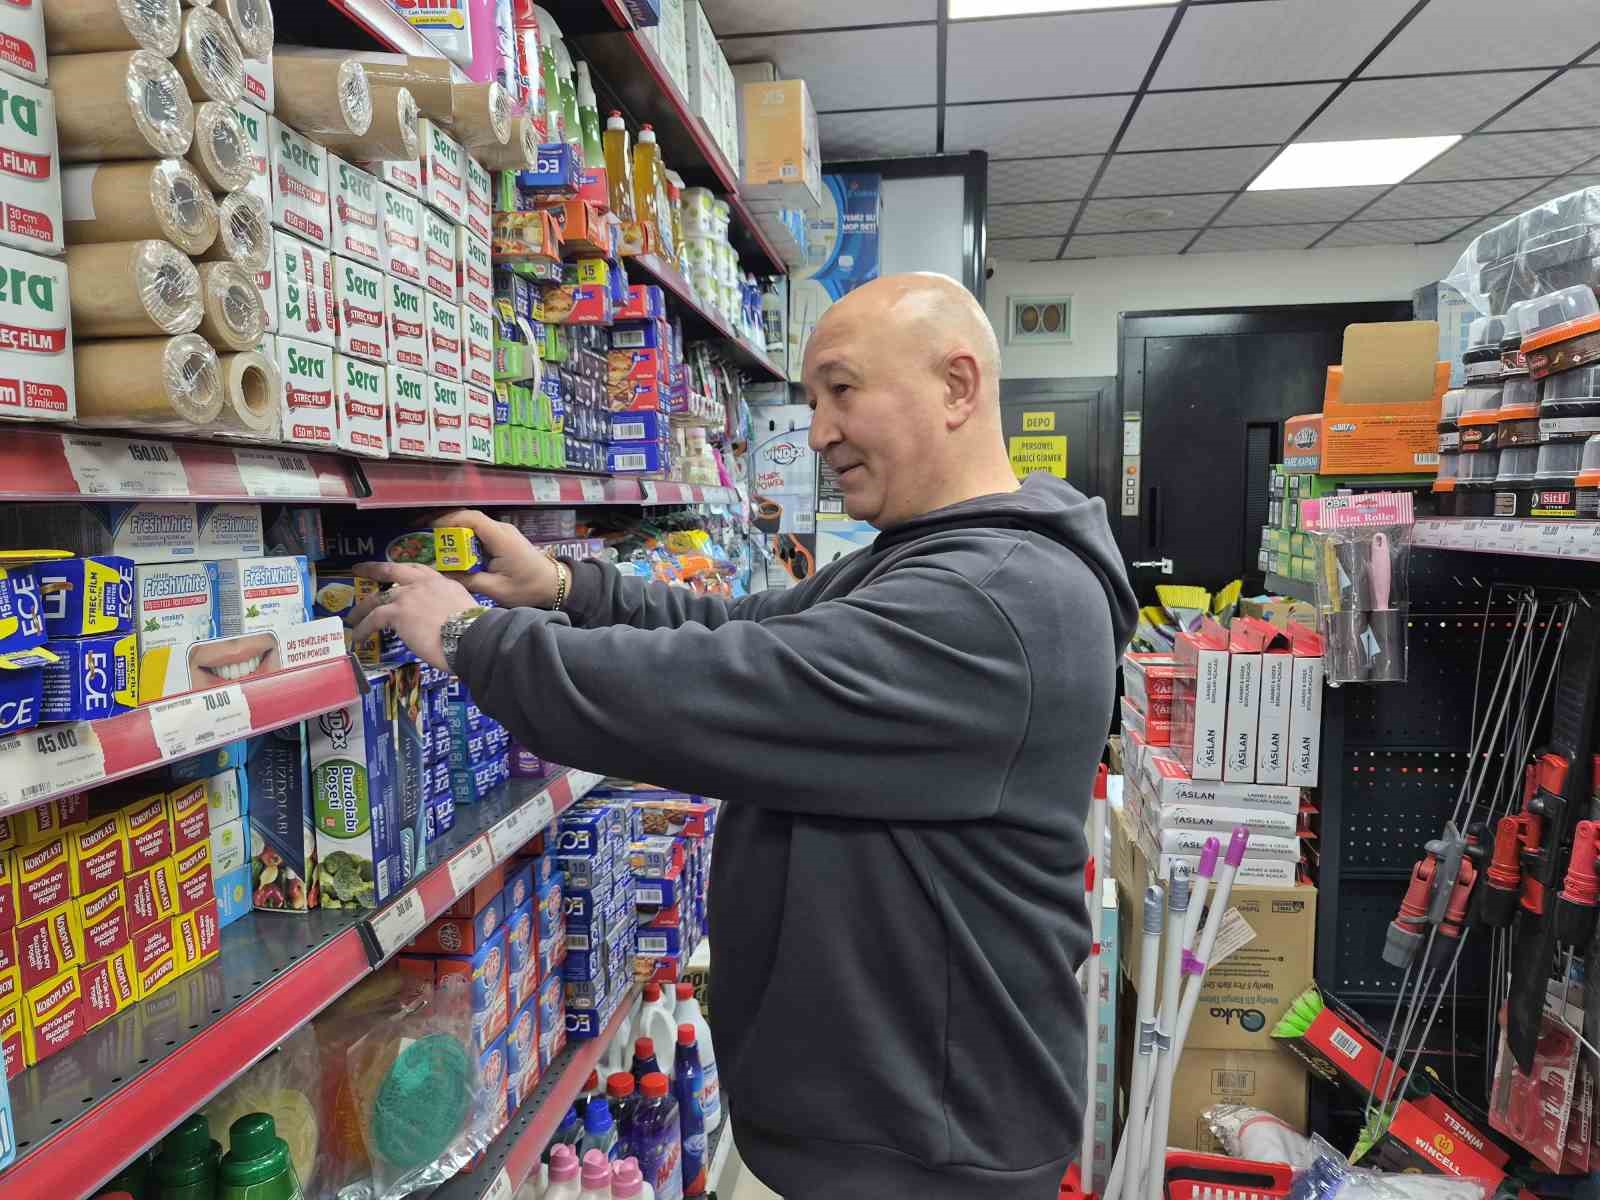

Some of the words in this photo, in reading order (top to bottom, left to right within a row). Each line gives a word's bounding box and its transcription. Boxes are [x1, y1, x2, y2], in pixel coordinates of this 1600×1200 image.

[6, 36, 20, 50] cm
[1, 50, 34, 68] mikron
[280, 131, 319, 176] Sera
[433, 130, 457, 164] Sera
[339, 164, 372, 200] Sera
[467, 160, 488, 192] Sera
[9, 207, 22, 220] 30
[22, 212, 38, 224] cm
[386, 192, 414, 224] Sera
[10, 220, 16, 231] 8
[17, 223, 51, 240] mikron
[467, 239, 487, 266] Sera
[584, 264, 595, 275] 15
[285, 254, 301, 320] Sera
[345, 268, 377, 300] Sera
[393, 285, 418, 312] Sera
[433, 302, 454, 329] Sera
[470, 314, 488, 340] Sera
[20, 329, 53, 350] FİLM
[288, 348, 324, 378] Sera
[348, 362, 378, 392] Sera
[397, 374, 421, 399] Sera
[26, 384, 37, 396] 30
[38, 387, 53, 398] cm
[27, 396, 33, 407] 8
[34, 397, 65, 411] mikron
[435, 382, 457, 405] Sera
[1026, 418, 1050, 428] DEPO
[129, 444, 169, 463] 150.00
[1021, 441, 1054, 451] PERSONEL
[130, 514, 193, 534] FreshWhite
[211, 514, 258, 534] FreshWhite
[1340, 513, 1361, 523] Lint
[1364, 512, 1395, 523] Roller
[329, 536, 374, 556] FİLM
[440, 533, 455, 547] 15
[143, 573, 206, 599] FreshWhite
[243, 565, 298, 587] FreshWhite
[119, 566, 134, 619] ECE
[1, 604, 13, 618] 15
[106, 603, 116, 616] 15
[287, 652, 306, 665] TOOTH
[307, 646, 331, 662] POWDER
[85, 653, 107, 711] ECE
[202, 691, 231, 711] 70.00
[36, 729, 78, 755] 45.00
[1206, 730, 1216, 761] ASLAN
[1239, 733, 1248, 765] ASLAN
[1271, 733, 1280, 765] ASLAN
[1302, 737, 1312, 769] ASLAN
[327, 766, 341, 809] Poşeti
[342, 766, 356, 833] Buzdolabı
[1180, 791, 1216, 801] ASLAN
[130, 802, 161, 827] KOROPLAST
[1178, 816, 1214, 825] ASLAN
[82, 822, 115, 849] KOROPLAST
[24, 841, 62, 871] KOROPLAST
[55, 914, 74, 961] KOROPLAST
[35, 979, 75, 1014] KOROPLAST
[61, 1008, 77, 1021] BOY
[1415, 1135, 1464, 1176] WINCELL
